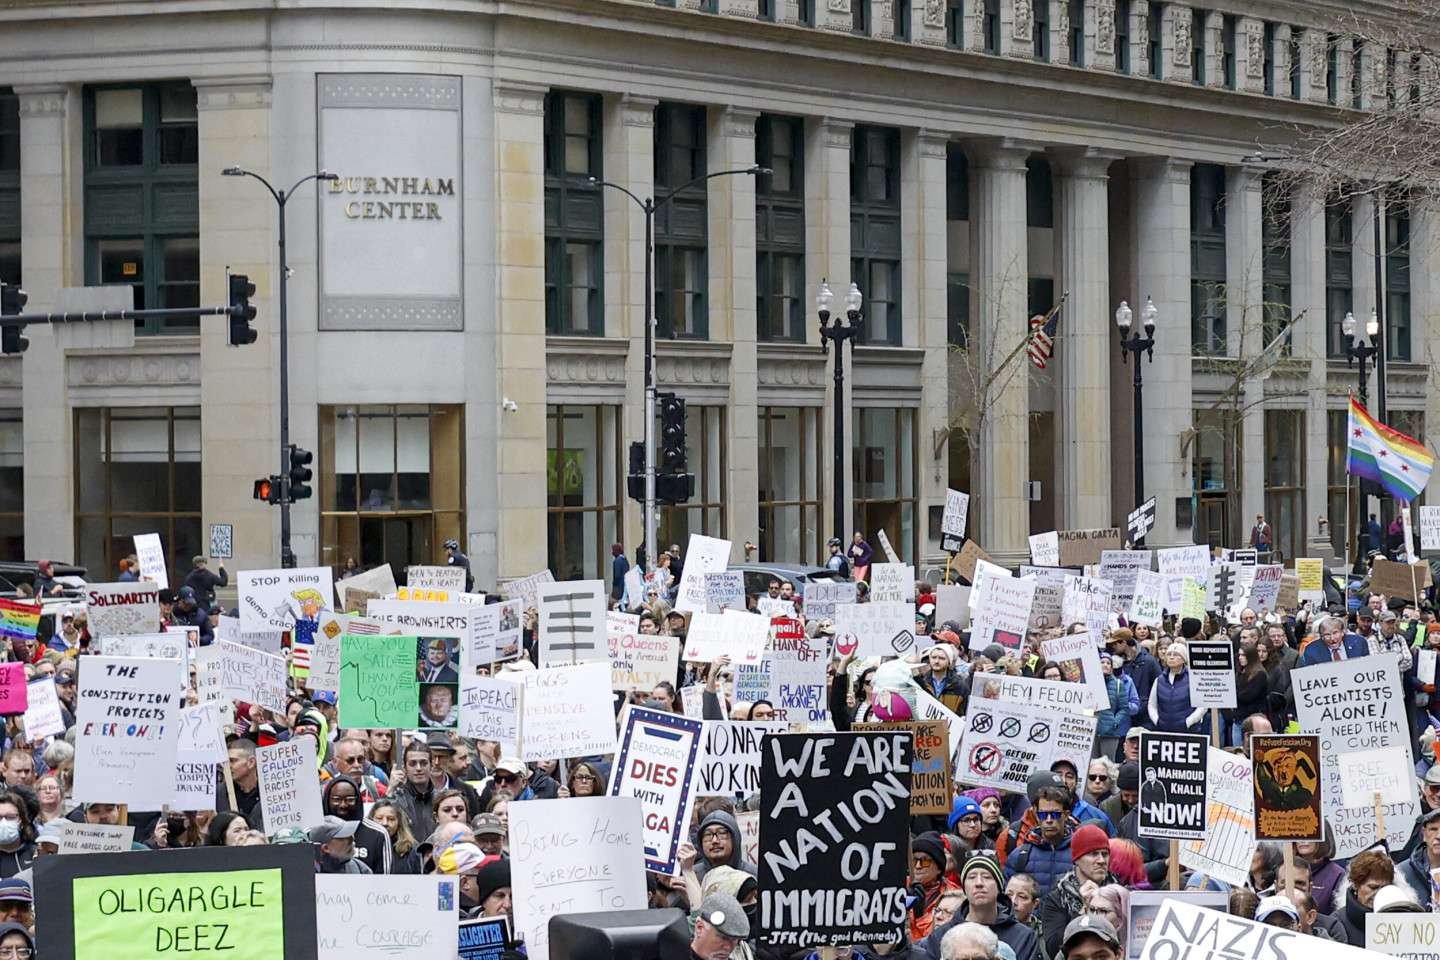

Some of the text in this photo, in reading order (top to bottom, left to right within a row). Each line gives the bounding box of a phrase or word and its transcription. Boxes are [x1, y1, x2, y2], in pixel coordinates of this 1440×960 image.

[328, 177, 455, 195] BURNHAM
[345, 202, 442, 220] CENTER
[251, 574, 320, 586] STOP Killing
[88, 590, 158, 607] SOLIDARITY
[620, 638, 669, 651] Queens
[773, 640, 810, 651] HANDS
[798, 650, 820, 661] OFF
[106, 665, 138, 679] THE
[1299, 670, 1386, 692] LEAVE OUR
[81, 687, 170, 704] CONSTITUTION
[737, 691, 756, 700] RISE
[1039, 687, 1083, 704] FELON
[107, 706, 165, 720] PROTECTS
[1321, 702, 1387, 721] ALONE!
[467, 725, 516, 738] ASSHOLE
[1332, 720, 1400, 736] NEED THEM
[1348, 736, 1390, 748] CURE
[262, 745, 299, 763] SUPER
[770, 735, 910, 777] WE ARE
[1006, 749, 1020, 758] GET
[1148, 741, 1200, 764] FREE
[631, 758, 678, 788] DIES
[1009, 762, 1029, 773] OUR
[1158, 767, 1204, 780] MAHMOUD
[264, 779, 295, 793] RACIST
[1171, 782, 1204, 796] KHALIL
[633, 788, 665, 805] WITH
[770, 782, 808, 819] A
[268, 803, 291, 814] NAZI
[1150, 803, 1201, 826] NOW!
[763, 771, 910, 884] NATION
[840, 842, 896, 881] OF
[99, 881, 265, 916] OLIGARGLE
[155, 924, 235, 952] DEEZ
[1372, 923, 1402, 944] SAY
[1413, 921, 1435, 944] NO
